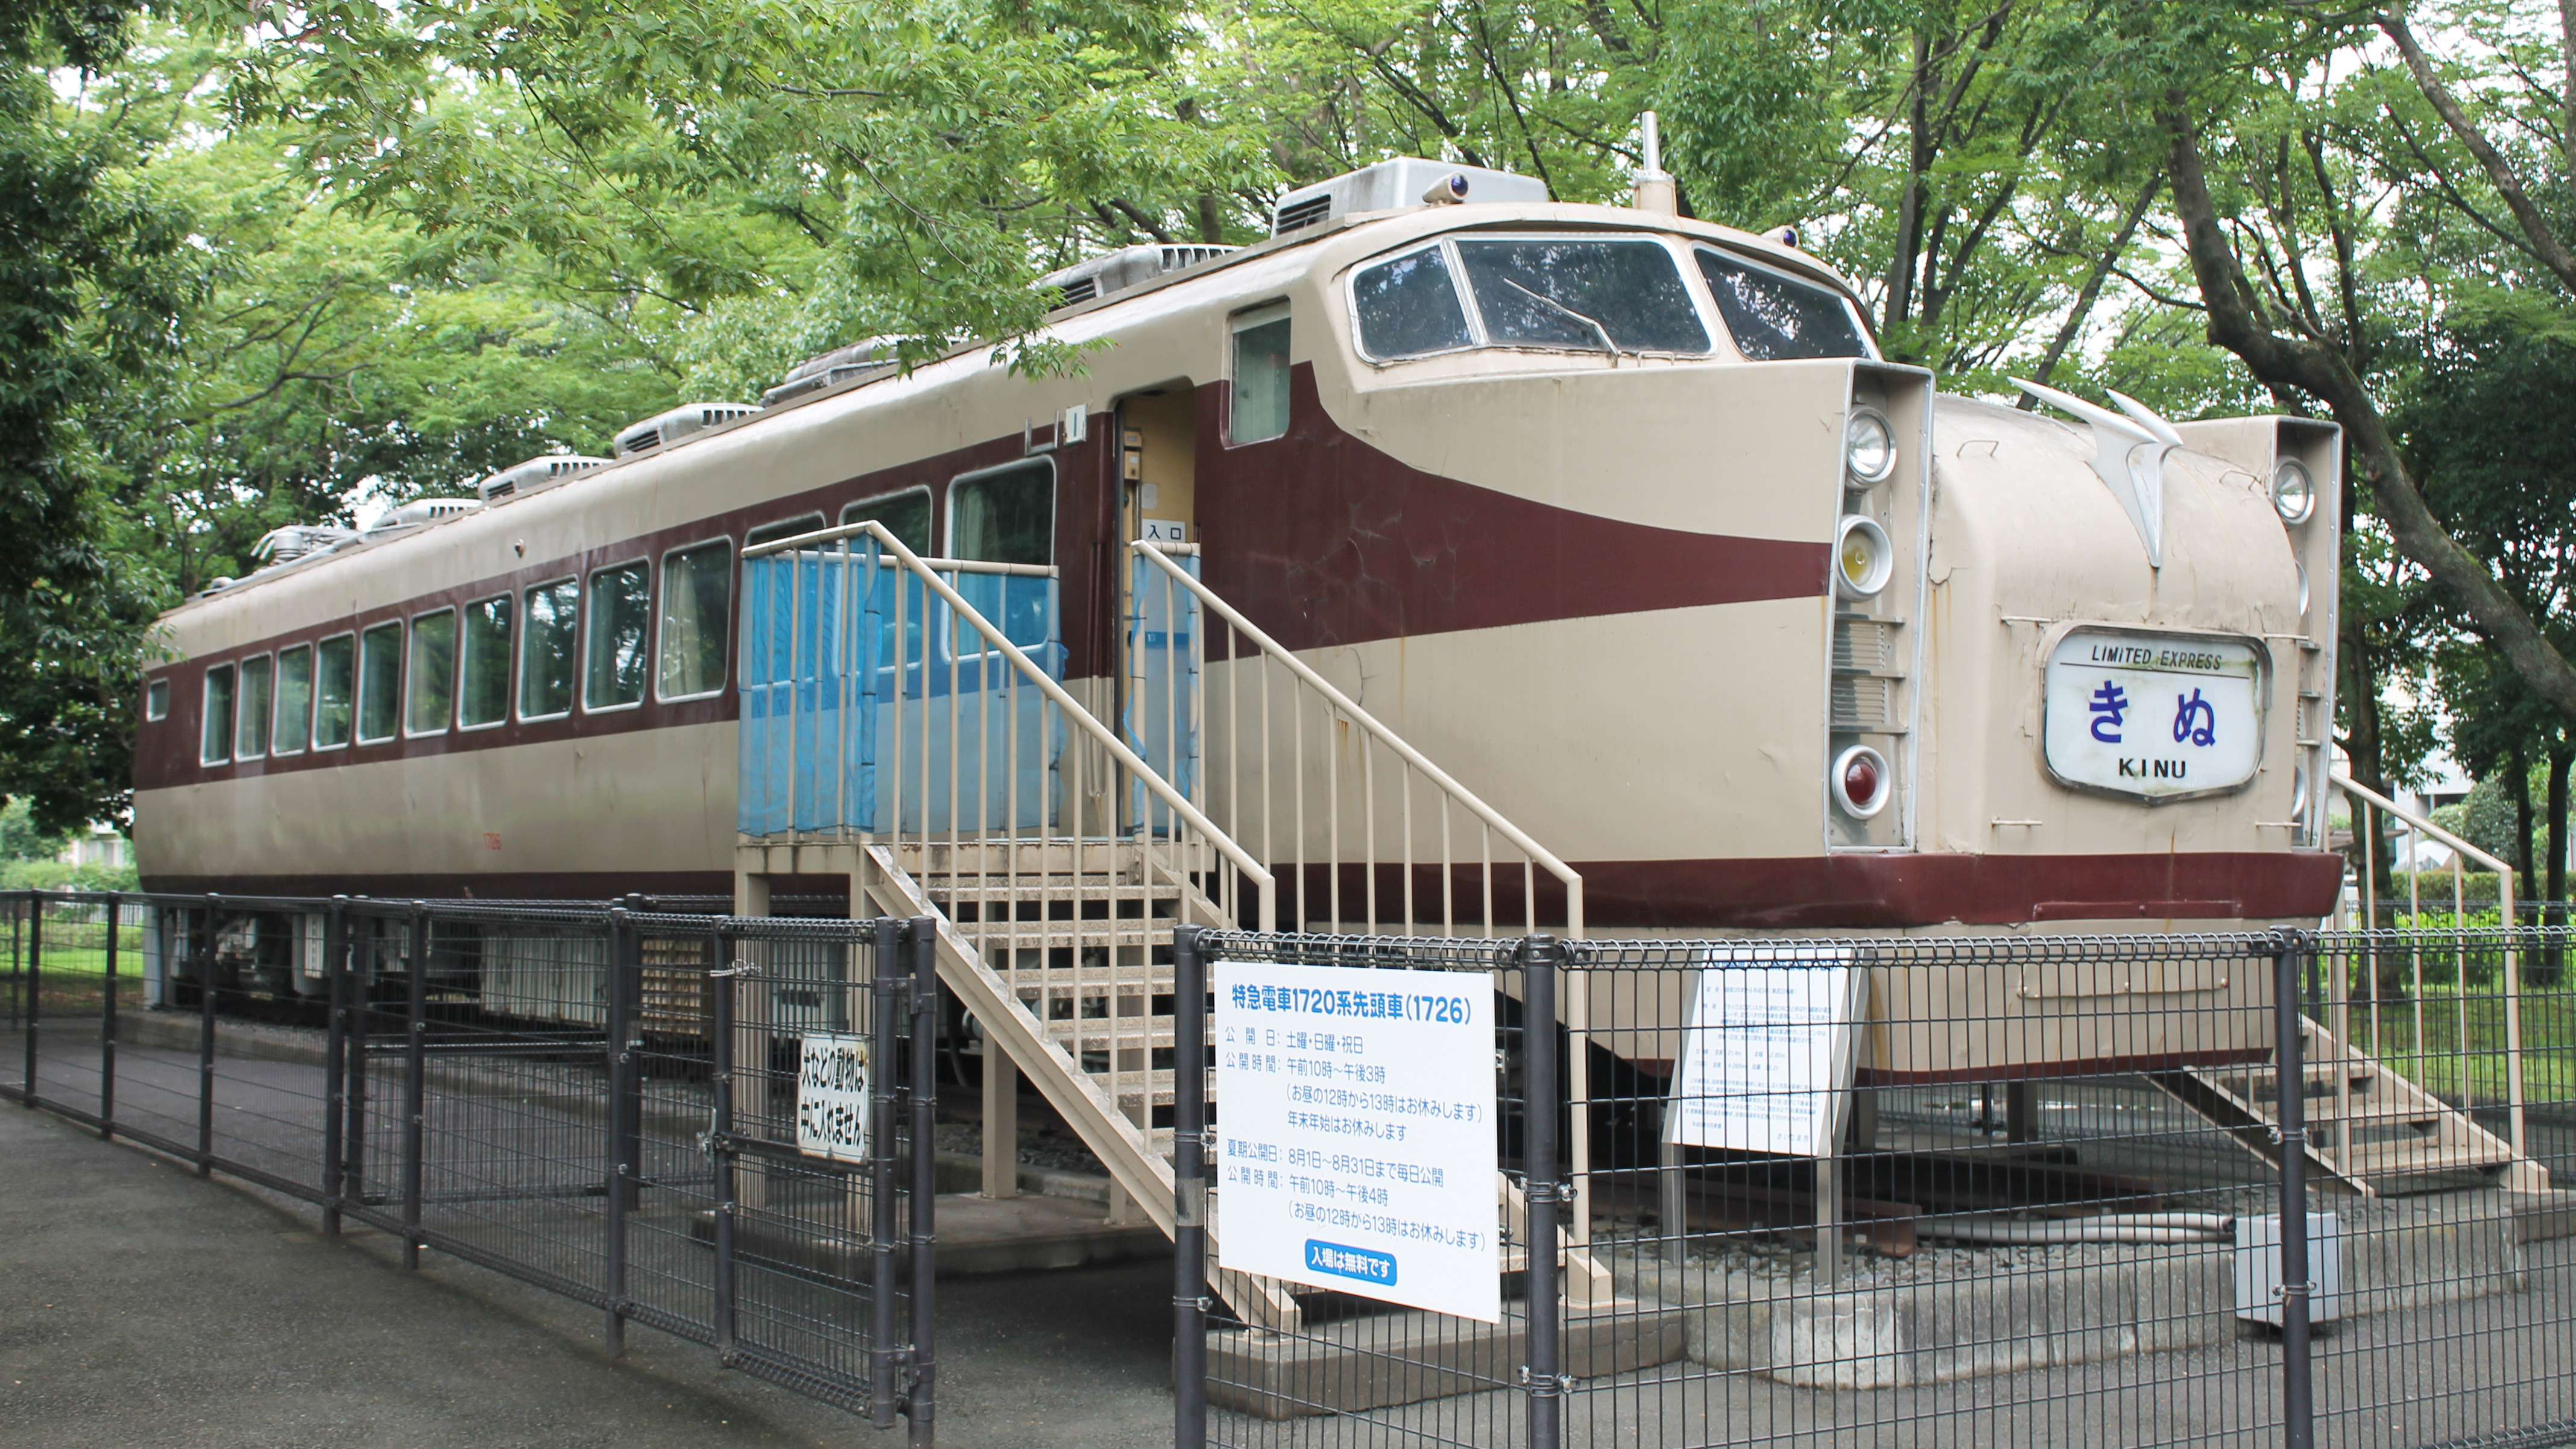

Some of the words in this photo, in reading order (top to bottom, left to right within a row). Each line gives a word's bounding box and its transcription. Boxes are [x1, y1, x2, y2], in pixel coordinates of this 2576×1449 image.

[1148, 525, 1182, 540] 入口
[2092, 645, 2151, 664] LIMITED
[2160, 650, 2221, 670] EXPRESS
[2119, 758, 2186, 778] KINU
[1232, 983, 1471, 1024] 特急電車1720系先頭車(1726)
[801, 1096, 860, 1147] 中に入れません
[1287, 1110, 1407, 1141] 年末年始はお休みします
[1311, 1245, 1391, 1278] 入場は無料です
